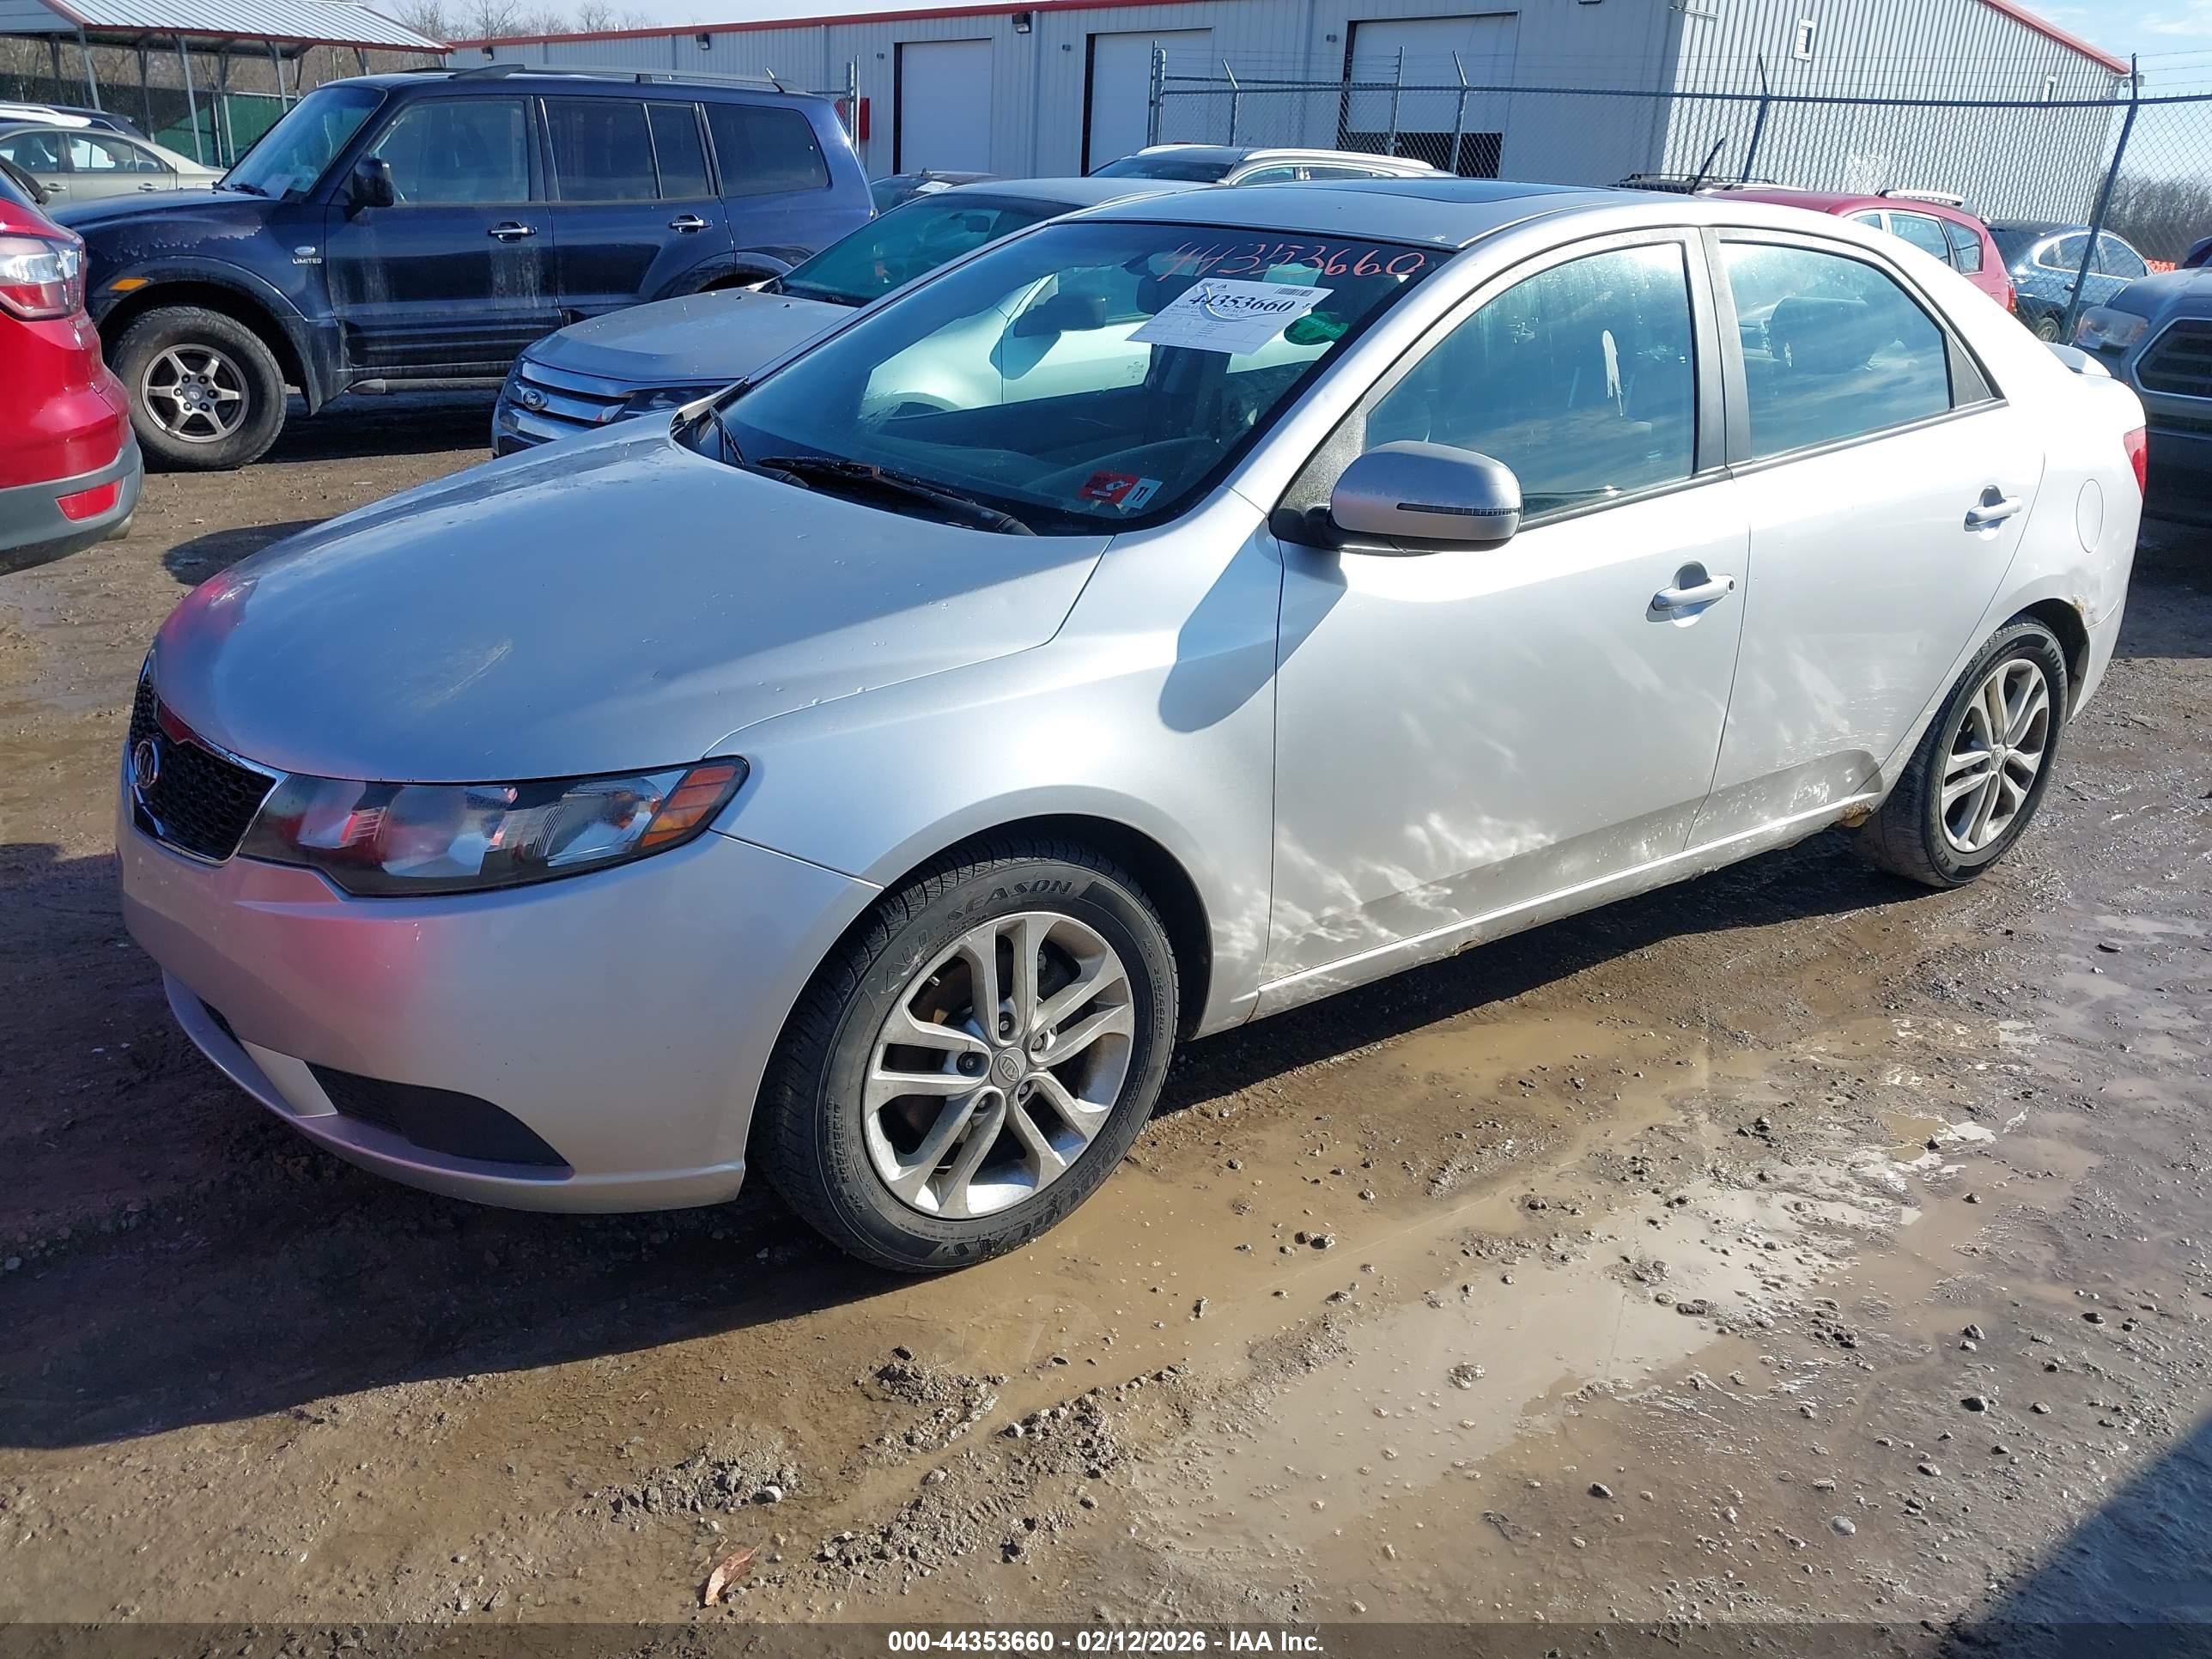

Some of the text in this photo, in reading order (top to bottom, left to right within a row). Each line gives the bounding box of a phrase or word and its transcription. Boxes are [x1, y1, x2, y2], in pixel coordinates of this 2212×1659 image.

[1156, 241, 1426, 282] 44353660
[1188, 293, 1296, 313] 44353660
[947, 878, 1073, 921] SEASON
